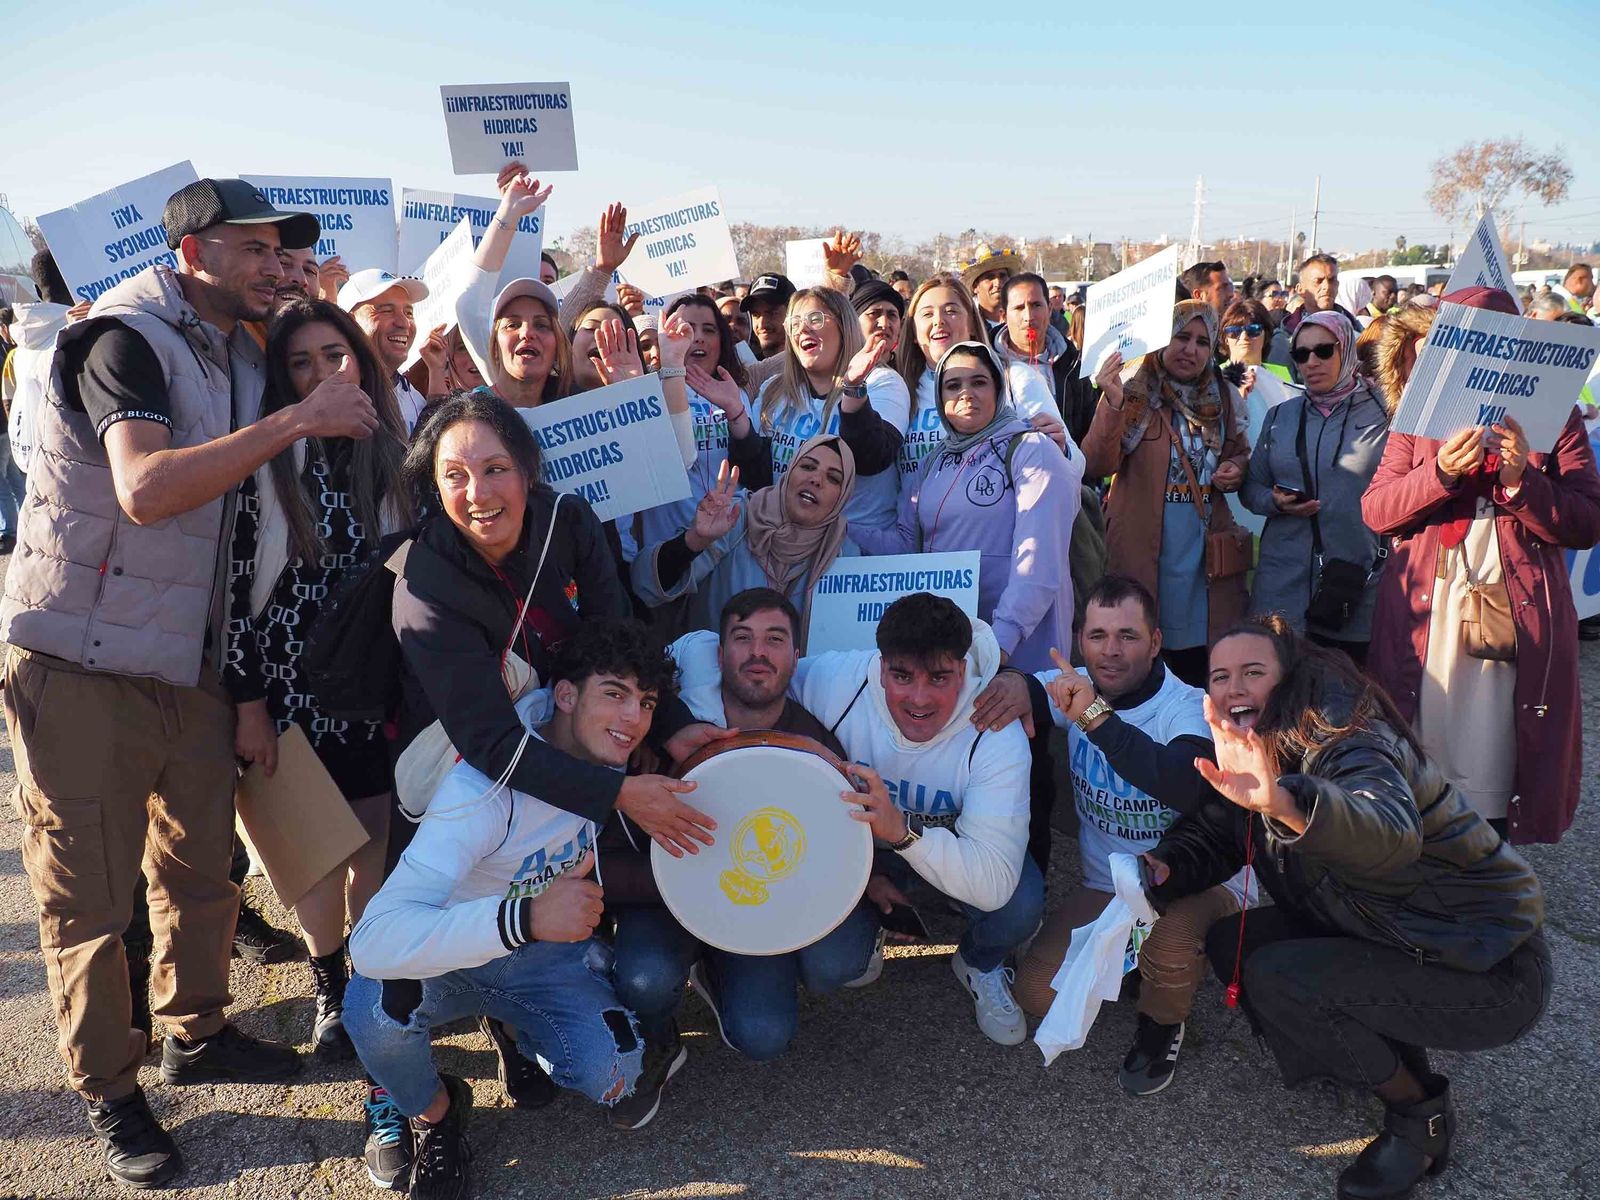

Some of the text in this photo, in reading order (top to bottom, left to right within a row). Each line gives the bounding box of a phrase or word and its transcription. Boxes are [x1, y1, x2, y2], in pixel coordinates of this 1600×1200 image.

[483, 118, 538, 135] HIDRICAS
[501, 141, 525, 157] YA!!
[258, 187, 389, 206] NFRAESTRUCTURAS
[111, 204, 143, 230] YA!!
[314, 213, 353, 230] RICAS
[622, 200, 720, 242] NFRAESTRUCTURAS
[645, 232, 697, 259] HIDRICAS
[665, 259, 689, 278] YA!!
[1109, 300, 1148, 330] HIDRICAS
[1118, 330, 1133, 349] YA!!
[1465, 366, 1539, 398] HIDRICAS
[532, 395, 662, 450] AESTRUCTURAS
[1475, 403, 1507, 427] YA!!
[929, 430, 942, 442] EL
[541, 441, 624, 484] HIDRICAS
[900, 461, 919, 474] PAR
[1096, 789, 1111, 807] EL
[1098, 819, 1165, 840] EL MUND
